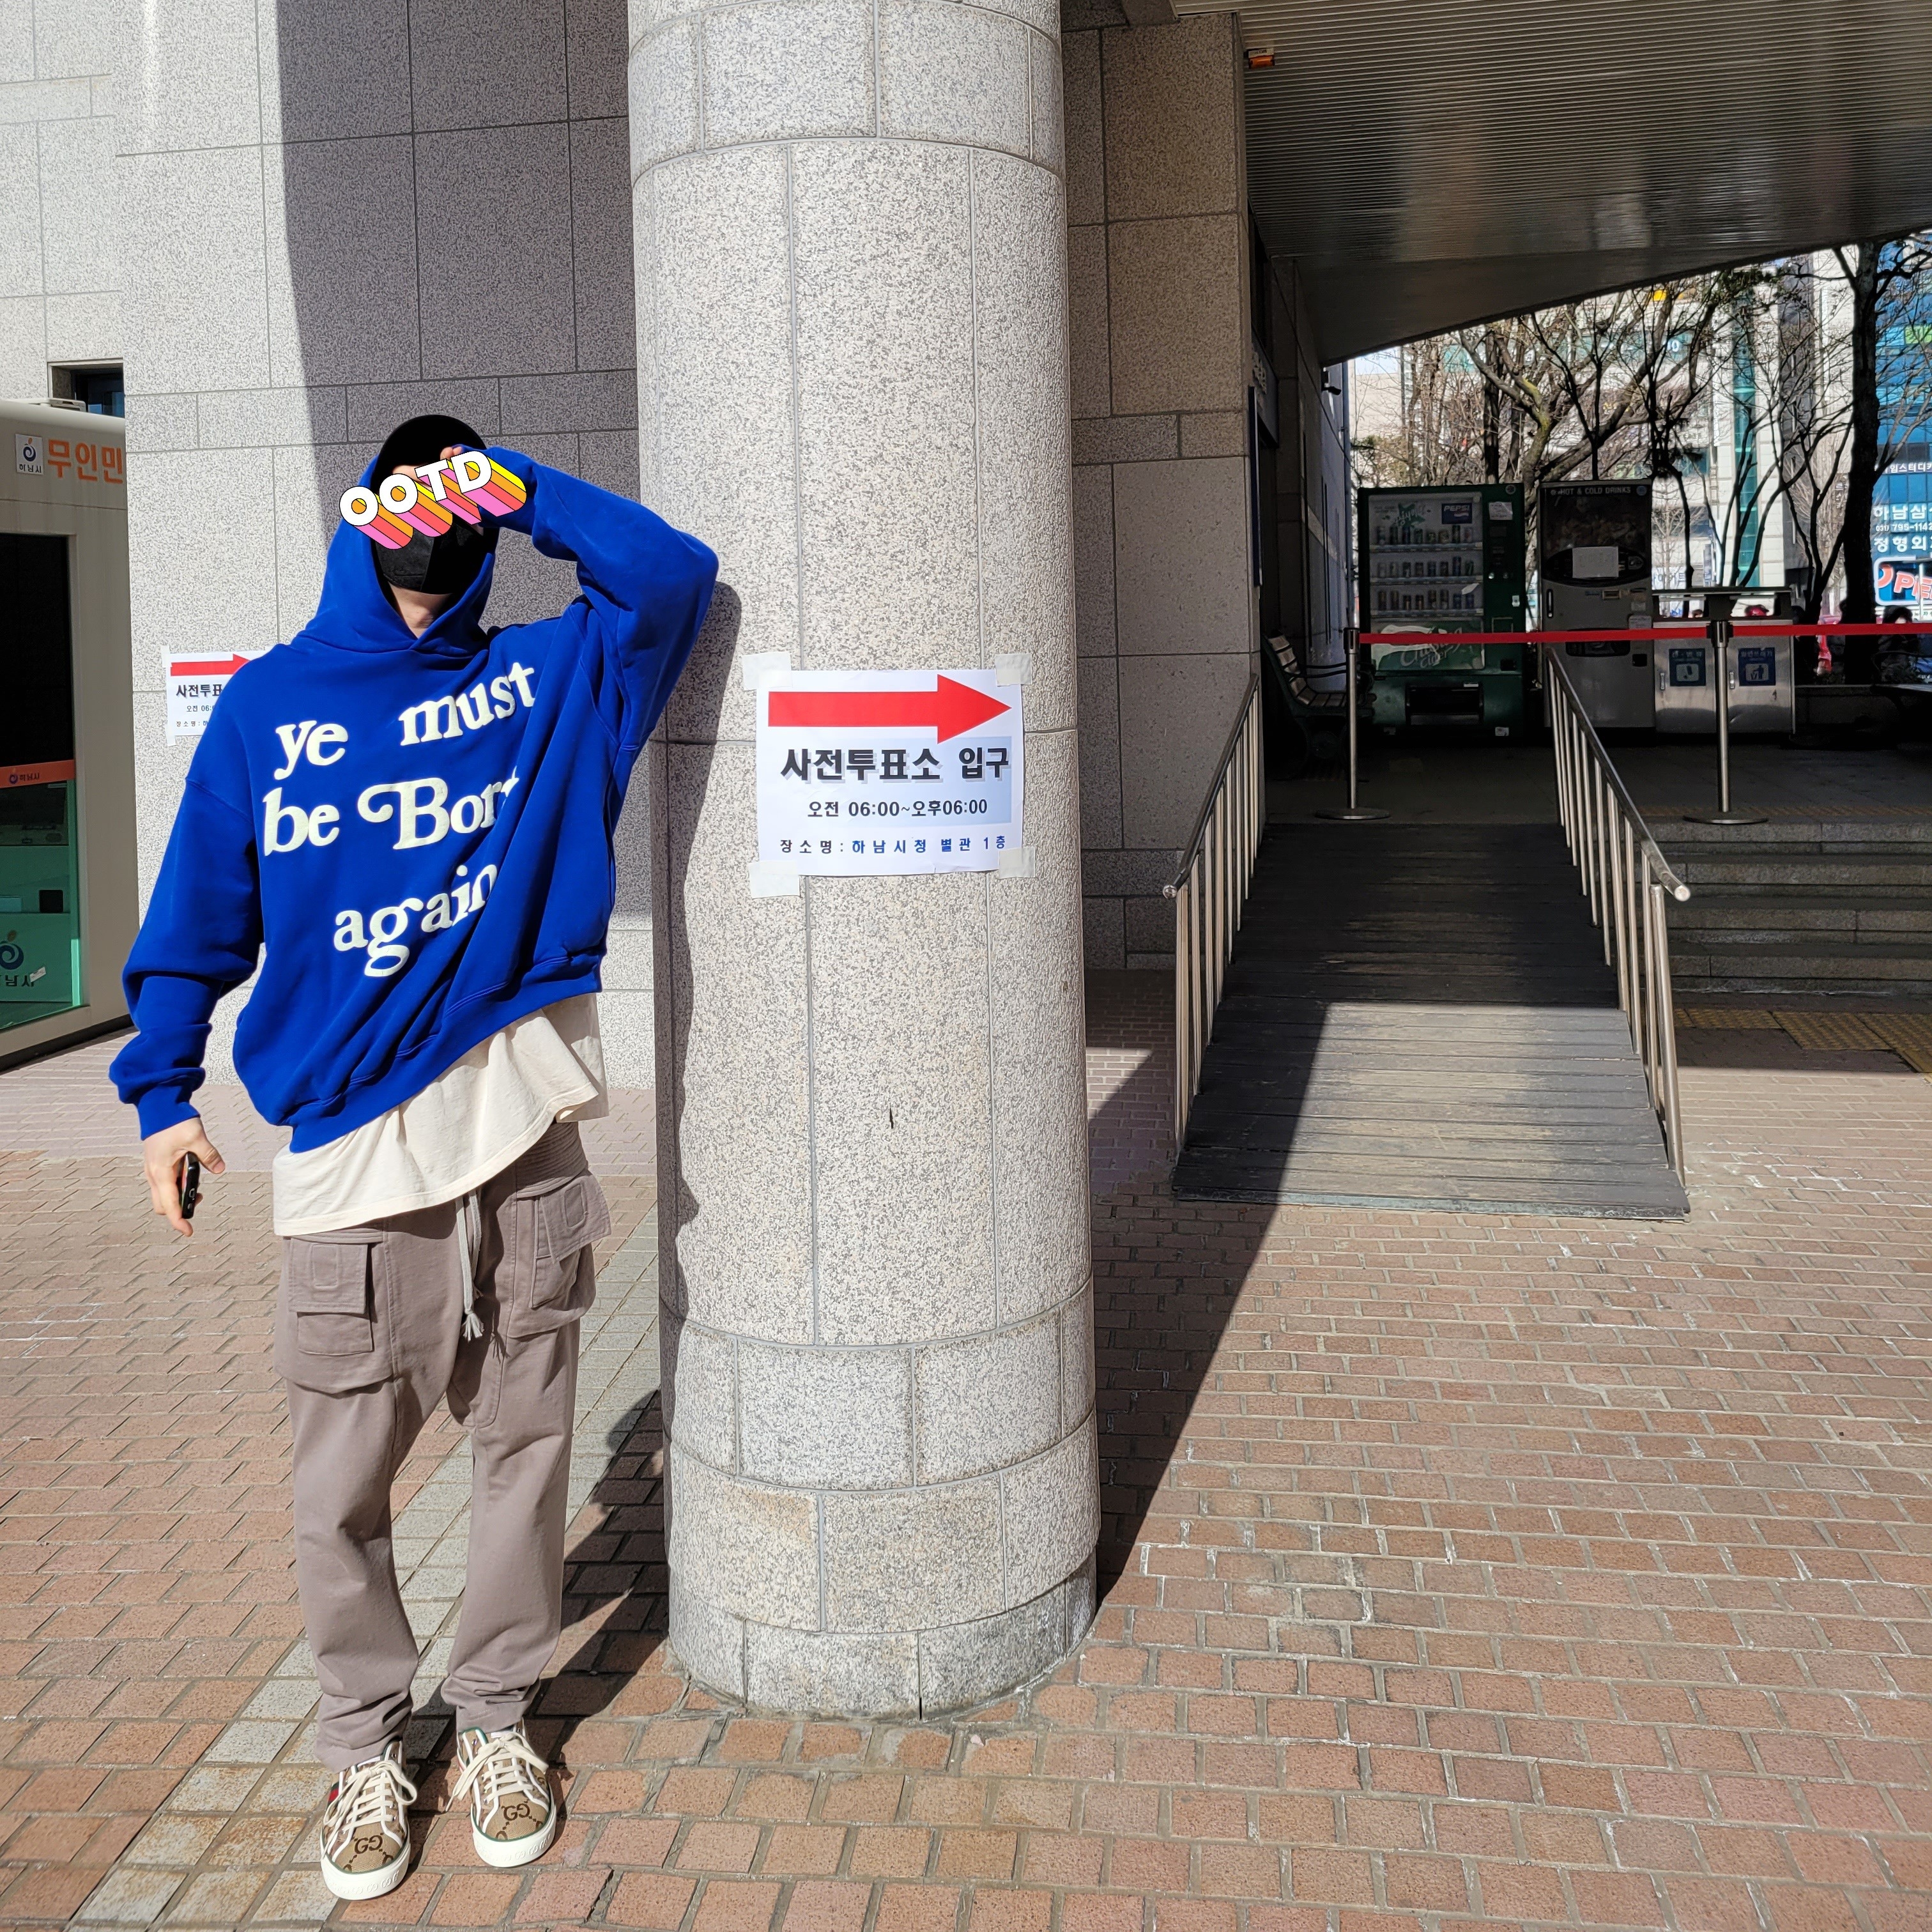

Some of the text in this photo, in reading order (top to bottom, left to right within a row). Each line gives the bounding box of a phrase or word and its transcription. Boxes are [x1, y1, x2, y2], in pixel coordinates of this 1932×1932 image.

[19, 464, 42, 473] 하남시
[1873, 503, 1932, 520] 하남삼
[1874, 535, 1932, 553] 정형외
[273, 662, 536, 780] ye must
[780, 747, 1010, 783] 사전투표소 입구
[263, 766, 519, 856] be Bor
[807, 801, 839, 818] 오전
[334, 864, 498, 977] again
[0, 974, 34, 987] 남시
